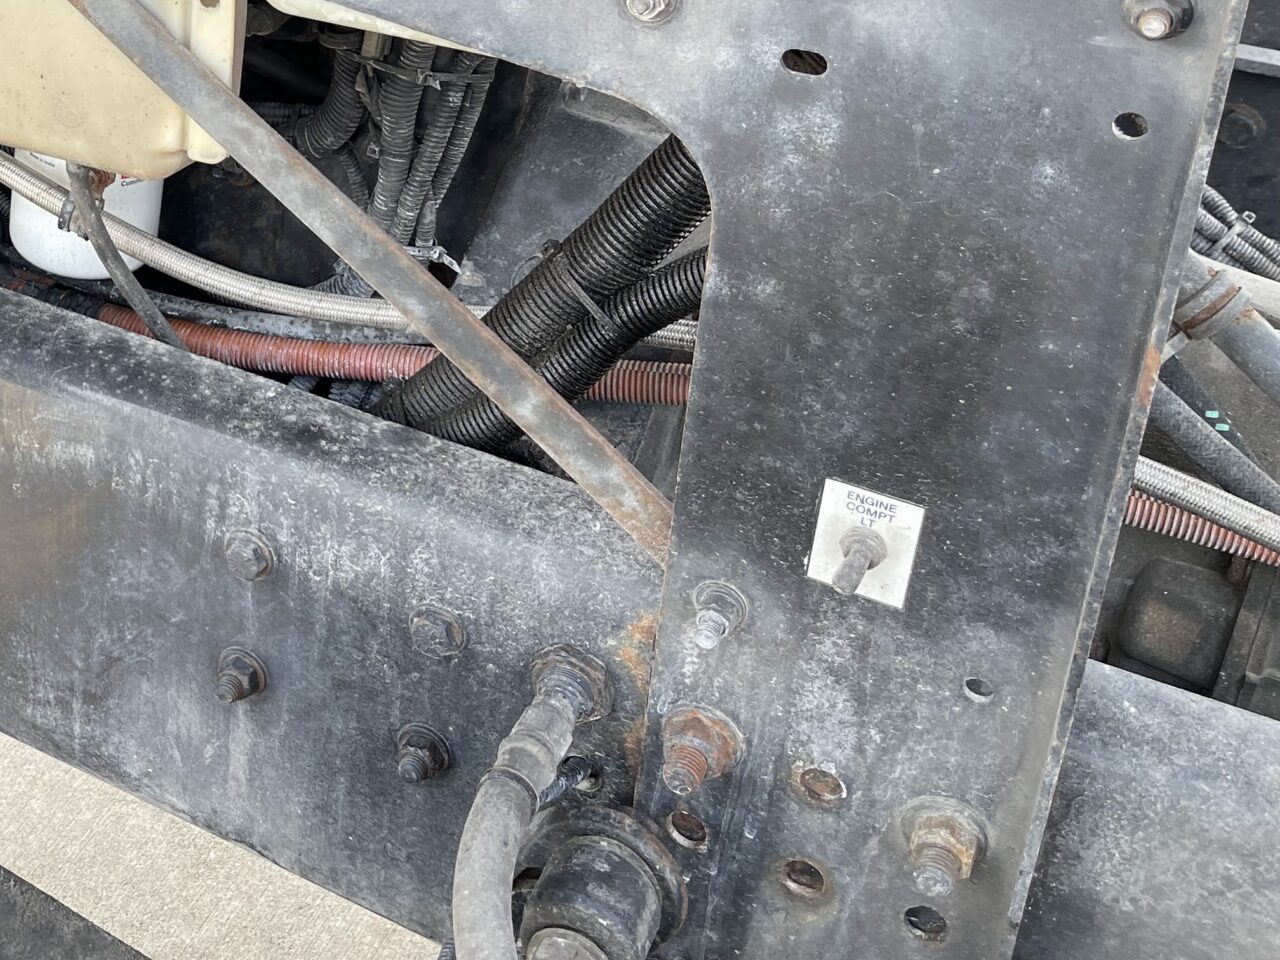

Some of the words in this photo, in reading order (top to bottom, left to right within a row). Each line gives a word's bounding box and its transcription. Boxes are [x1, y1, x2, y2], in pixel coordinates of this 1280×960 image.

[846, 501, 896, 524] COMPT
[847, 490, 898, 513] ENGINE
[860, 516, 876, 528] LT
